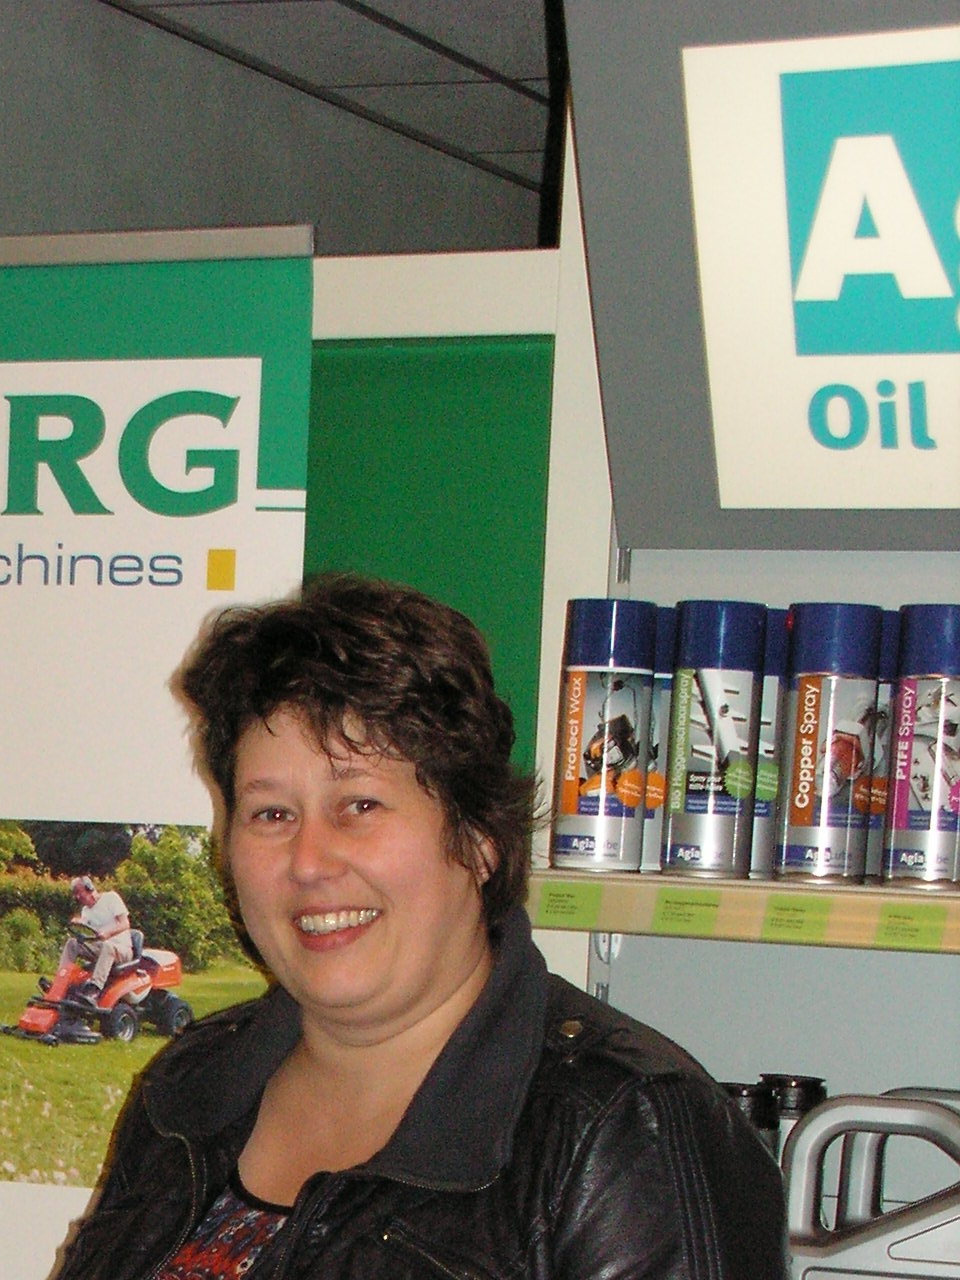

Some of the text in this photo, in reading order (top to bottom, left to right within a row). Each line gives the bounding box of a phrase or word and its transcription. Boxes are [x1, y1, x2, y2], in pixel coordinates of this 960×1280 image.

[793, 133, 960, 337] A
[807, 379, 938, 451] Oil
[565, 676, 583, 781] Protect Wax
[794, 684, 822, 809] Copper Spray
[895, 686, 916, 781] PTFE Spray
